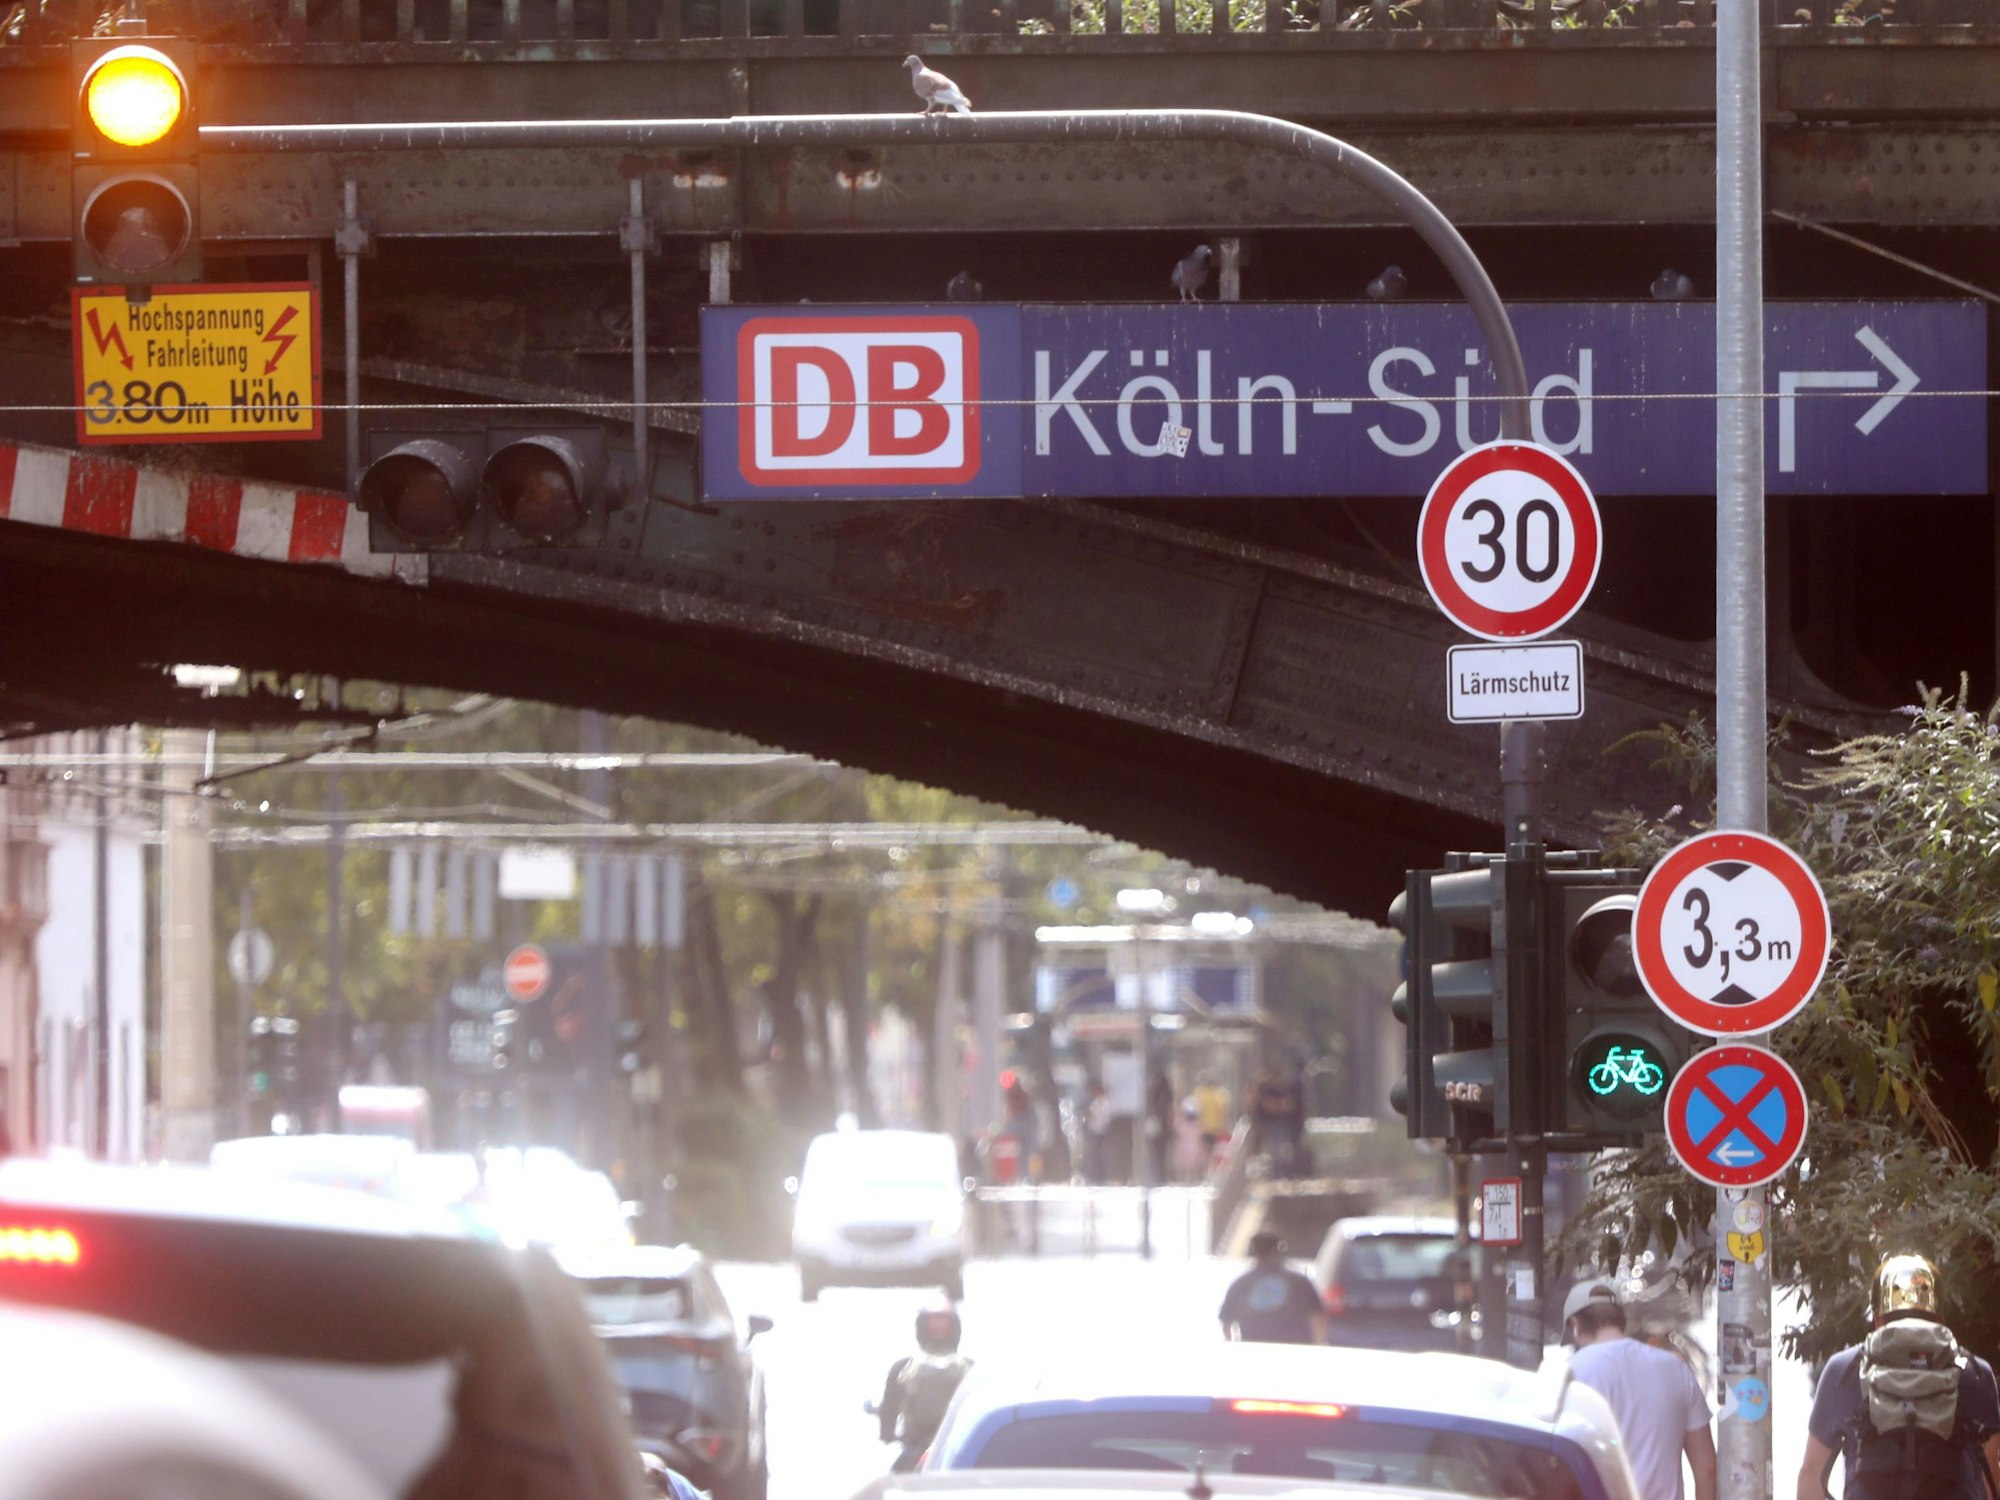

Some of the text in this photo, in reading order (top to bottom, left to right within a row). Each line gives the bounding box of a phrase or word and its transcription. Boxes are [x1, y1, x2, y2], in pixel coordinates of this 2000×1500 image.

[128, 303, 264, 335] Hochspannung
[147, 339, 247, 372] Fahrleitung
[230, 378, 300, 424] Höhe
[771, 345, 950, 456] DB
[1461, 499, 1560, 584] 30
[1459, 671, 1571, 697] Lärmschutz
